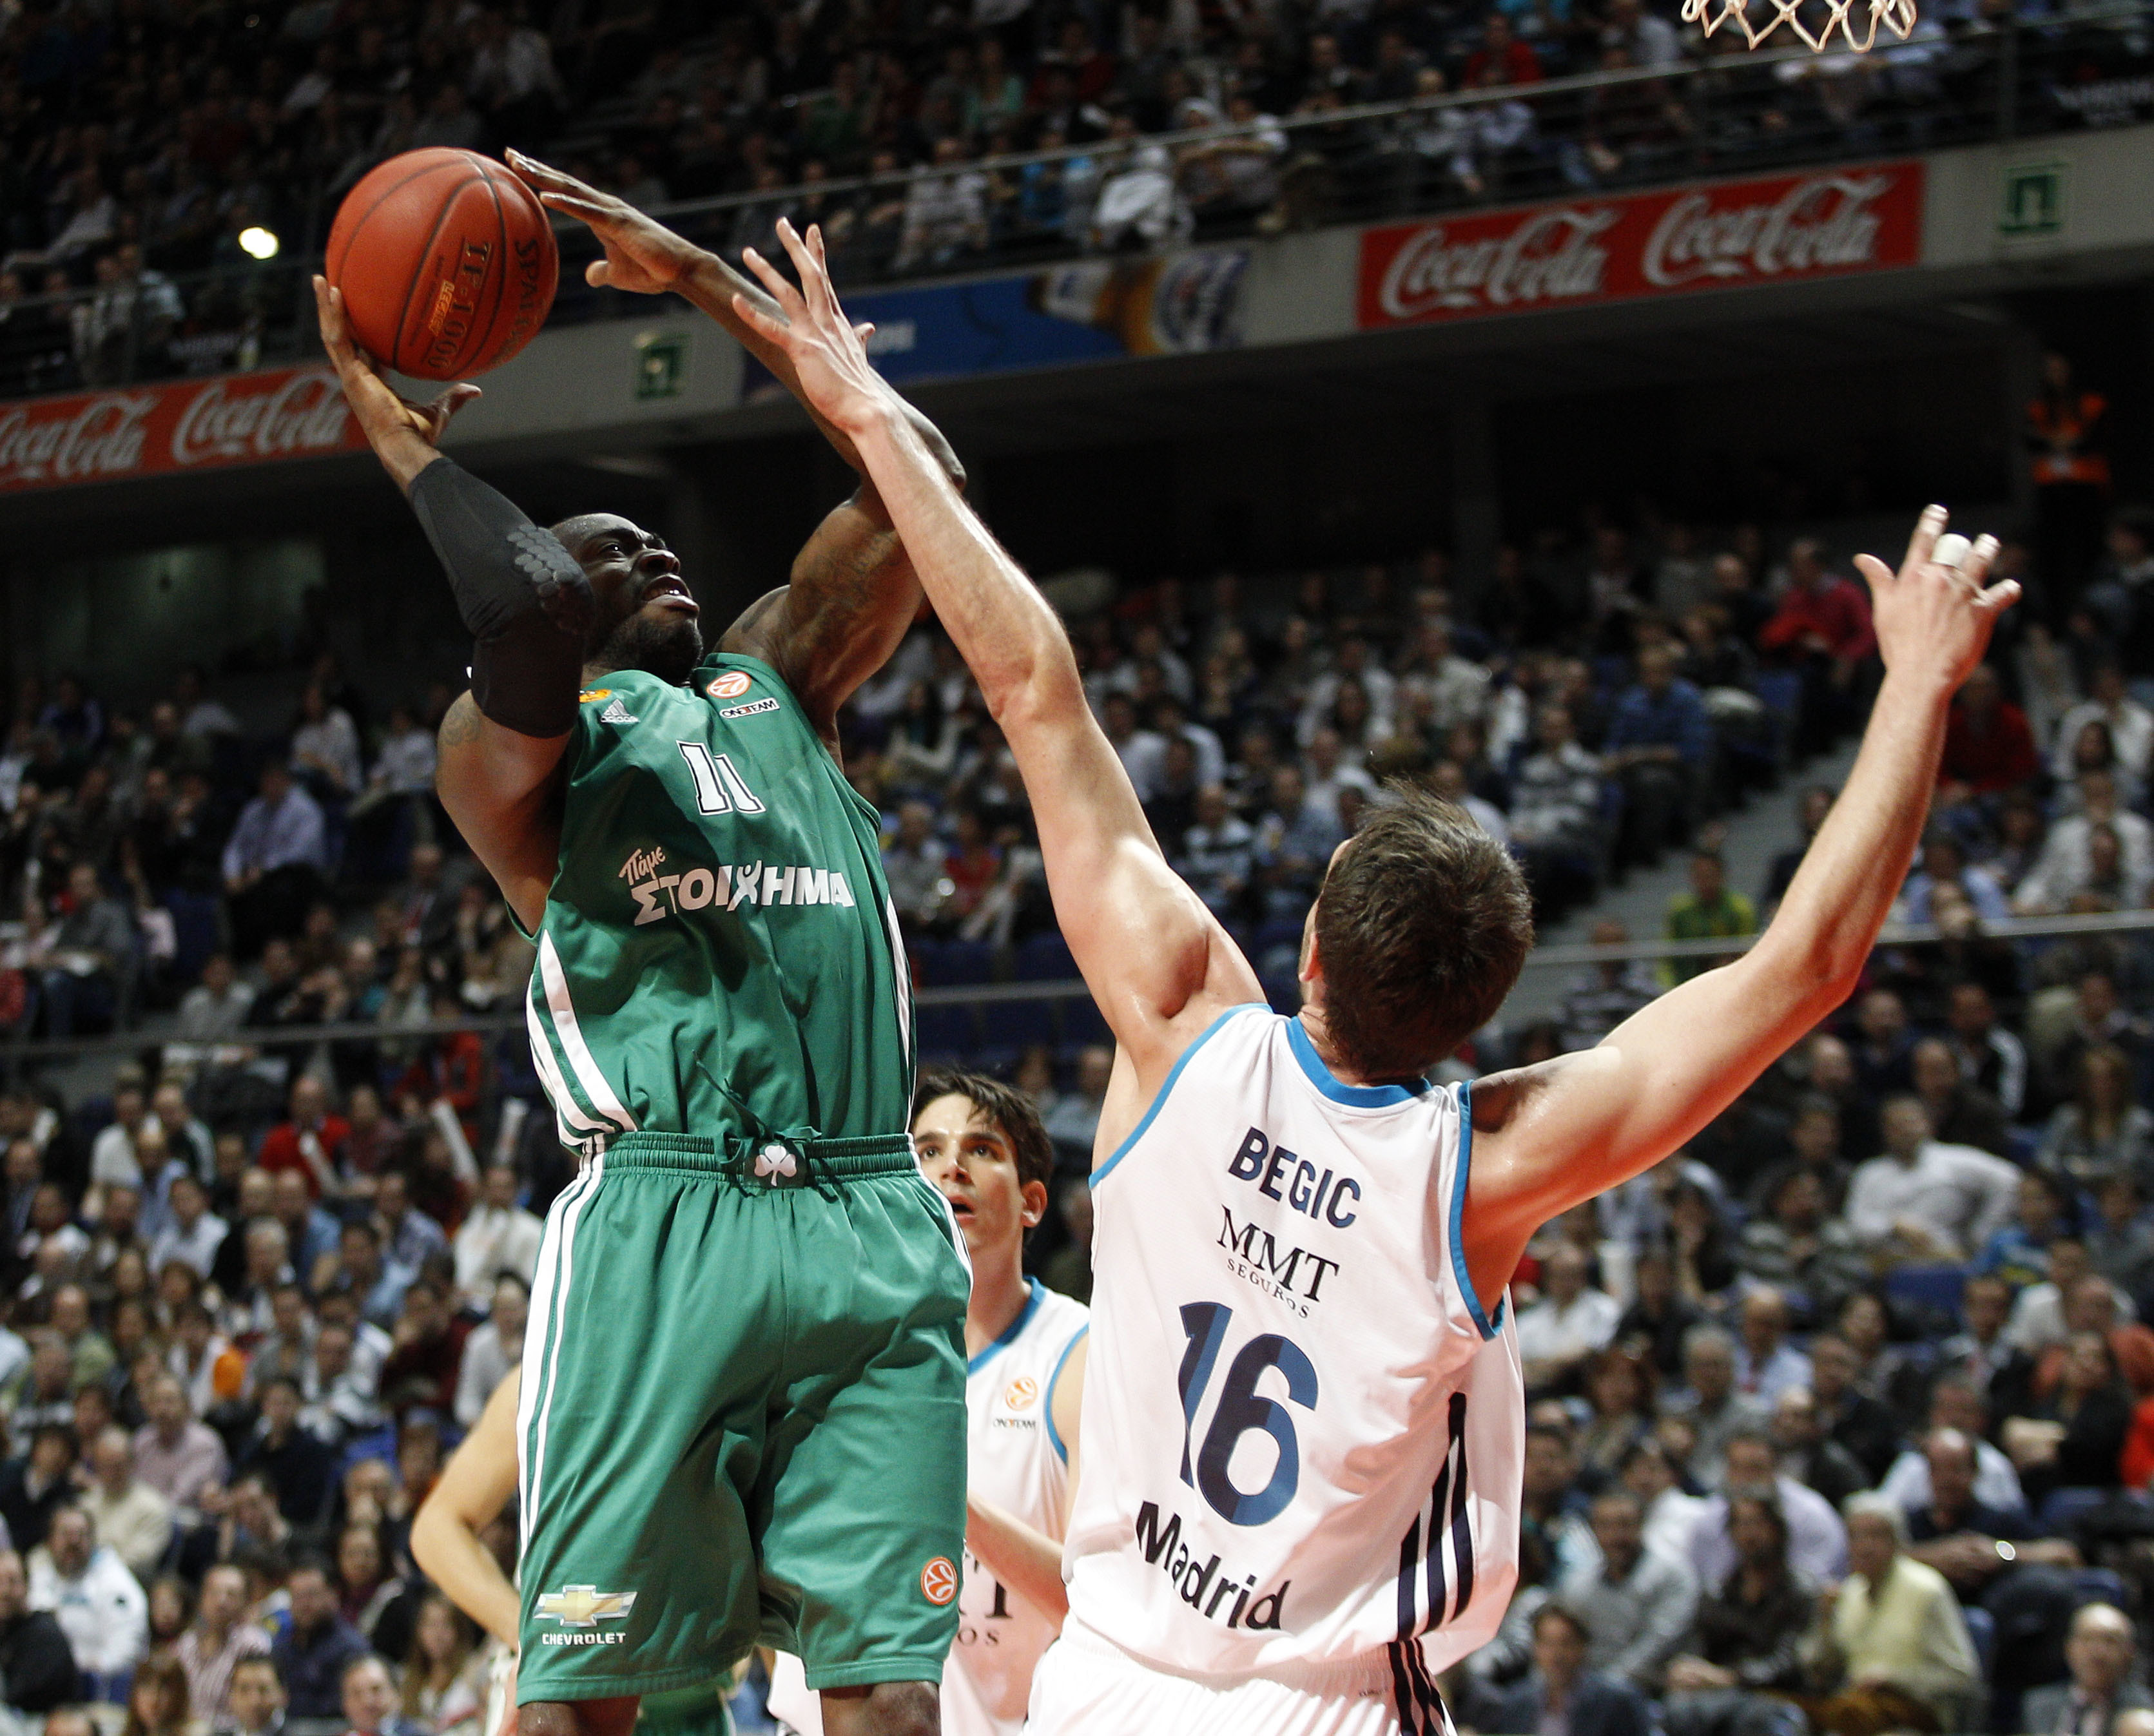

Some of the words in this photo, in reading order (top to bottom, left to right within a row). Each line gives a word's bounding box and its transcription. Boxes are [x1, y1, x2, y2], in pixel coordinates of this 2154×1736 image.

[676, 739, 766, 816] 11
[619, 846, 666, 884] Πάμε
[1228, 1126, 1361, 1229] BEGIC
[1216, 1203, 1340, 1302] MMT
[1227, 1257, 1311, 1320] SEGUROS
[1178, 1301, 1319, 1527] 16
[1136, 1500, 1292, 1630] Madrid
[541, 1632, 626, 1646] CHEVROLET
